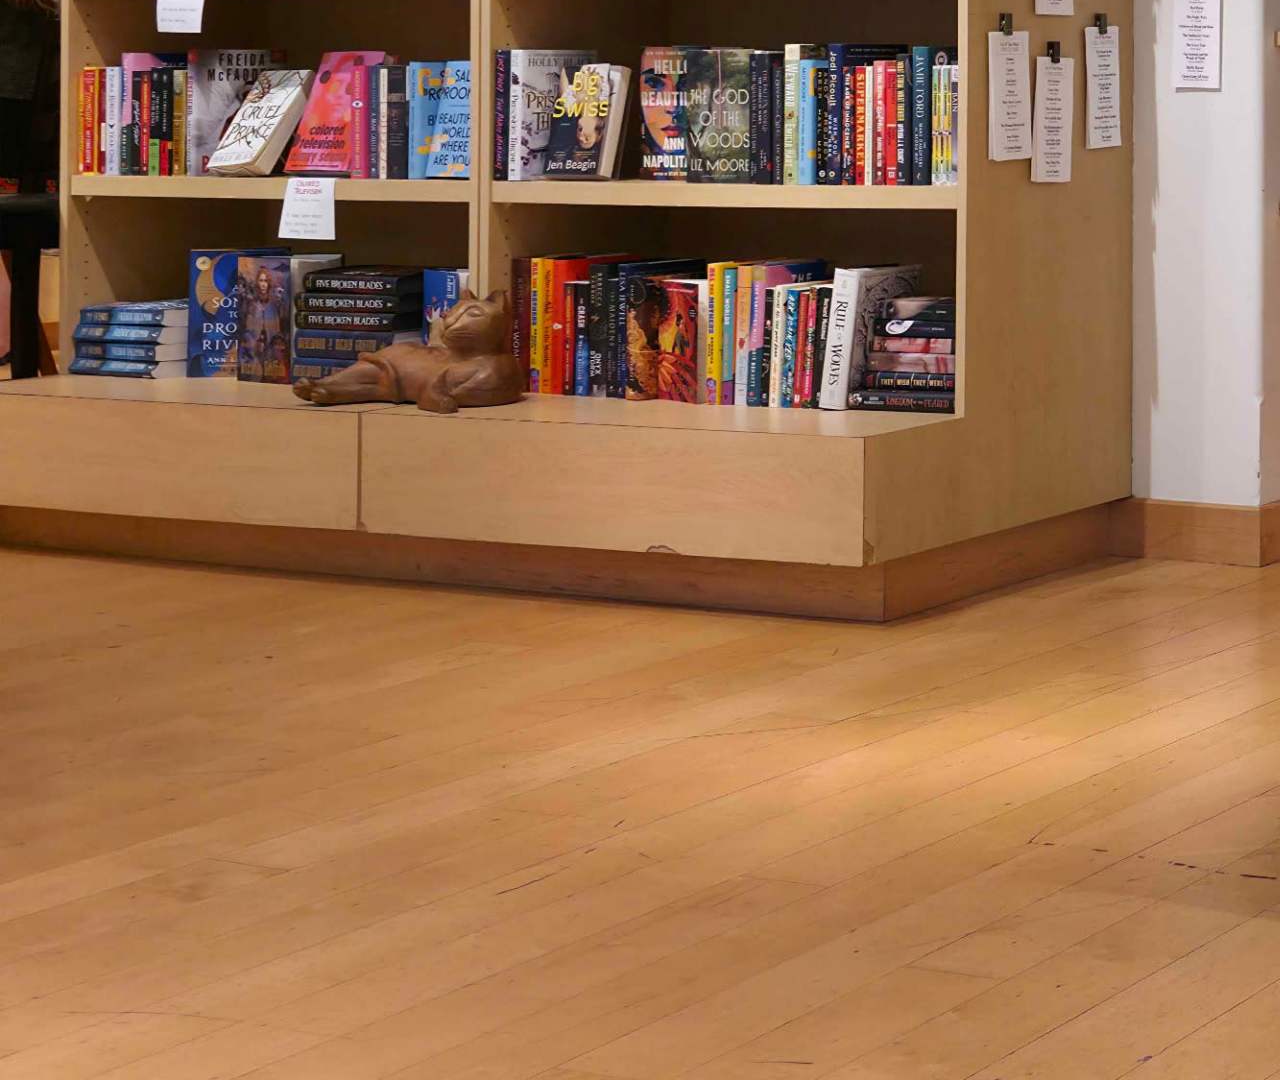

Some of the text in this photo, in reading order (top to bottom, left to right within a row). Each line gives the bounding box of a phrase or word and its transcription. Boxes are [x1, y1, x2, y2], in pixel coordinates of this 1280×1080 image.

[219, 53, 265, 66] FREIDA
[573, 71, 599, 93] Big
[828, 51, 838, 107] Jodi Picoult
[713, 88, 749, 104] GOD
[553, 97, 608, 119] Swiss
[700, 111, 739, 126] OF THE
[856, 73, 865, 167] SUPERMARKET
[689, 131, 750, 149] WOODS
[547, 158, 596, 172] Jen Beagin
[691, 158, 749, 171] LIZ MOORE
[315, 278, 384, 290] FIVE BROKEN BLADES
[829, 301, 848, 386] RULE WOLVES
